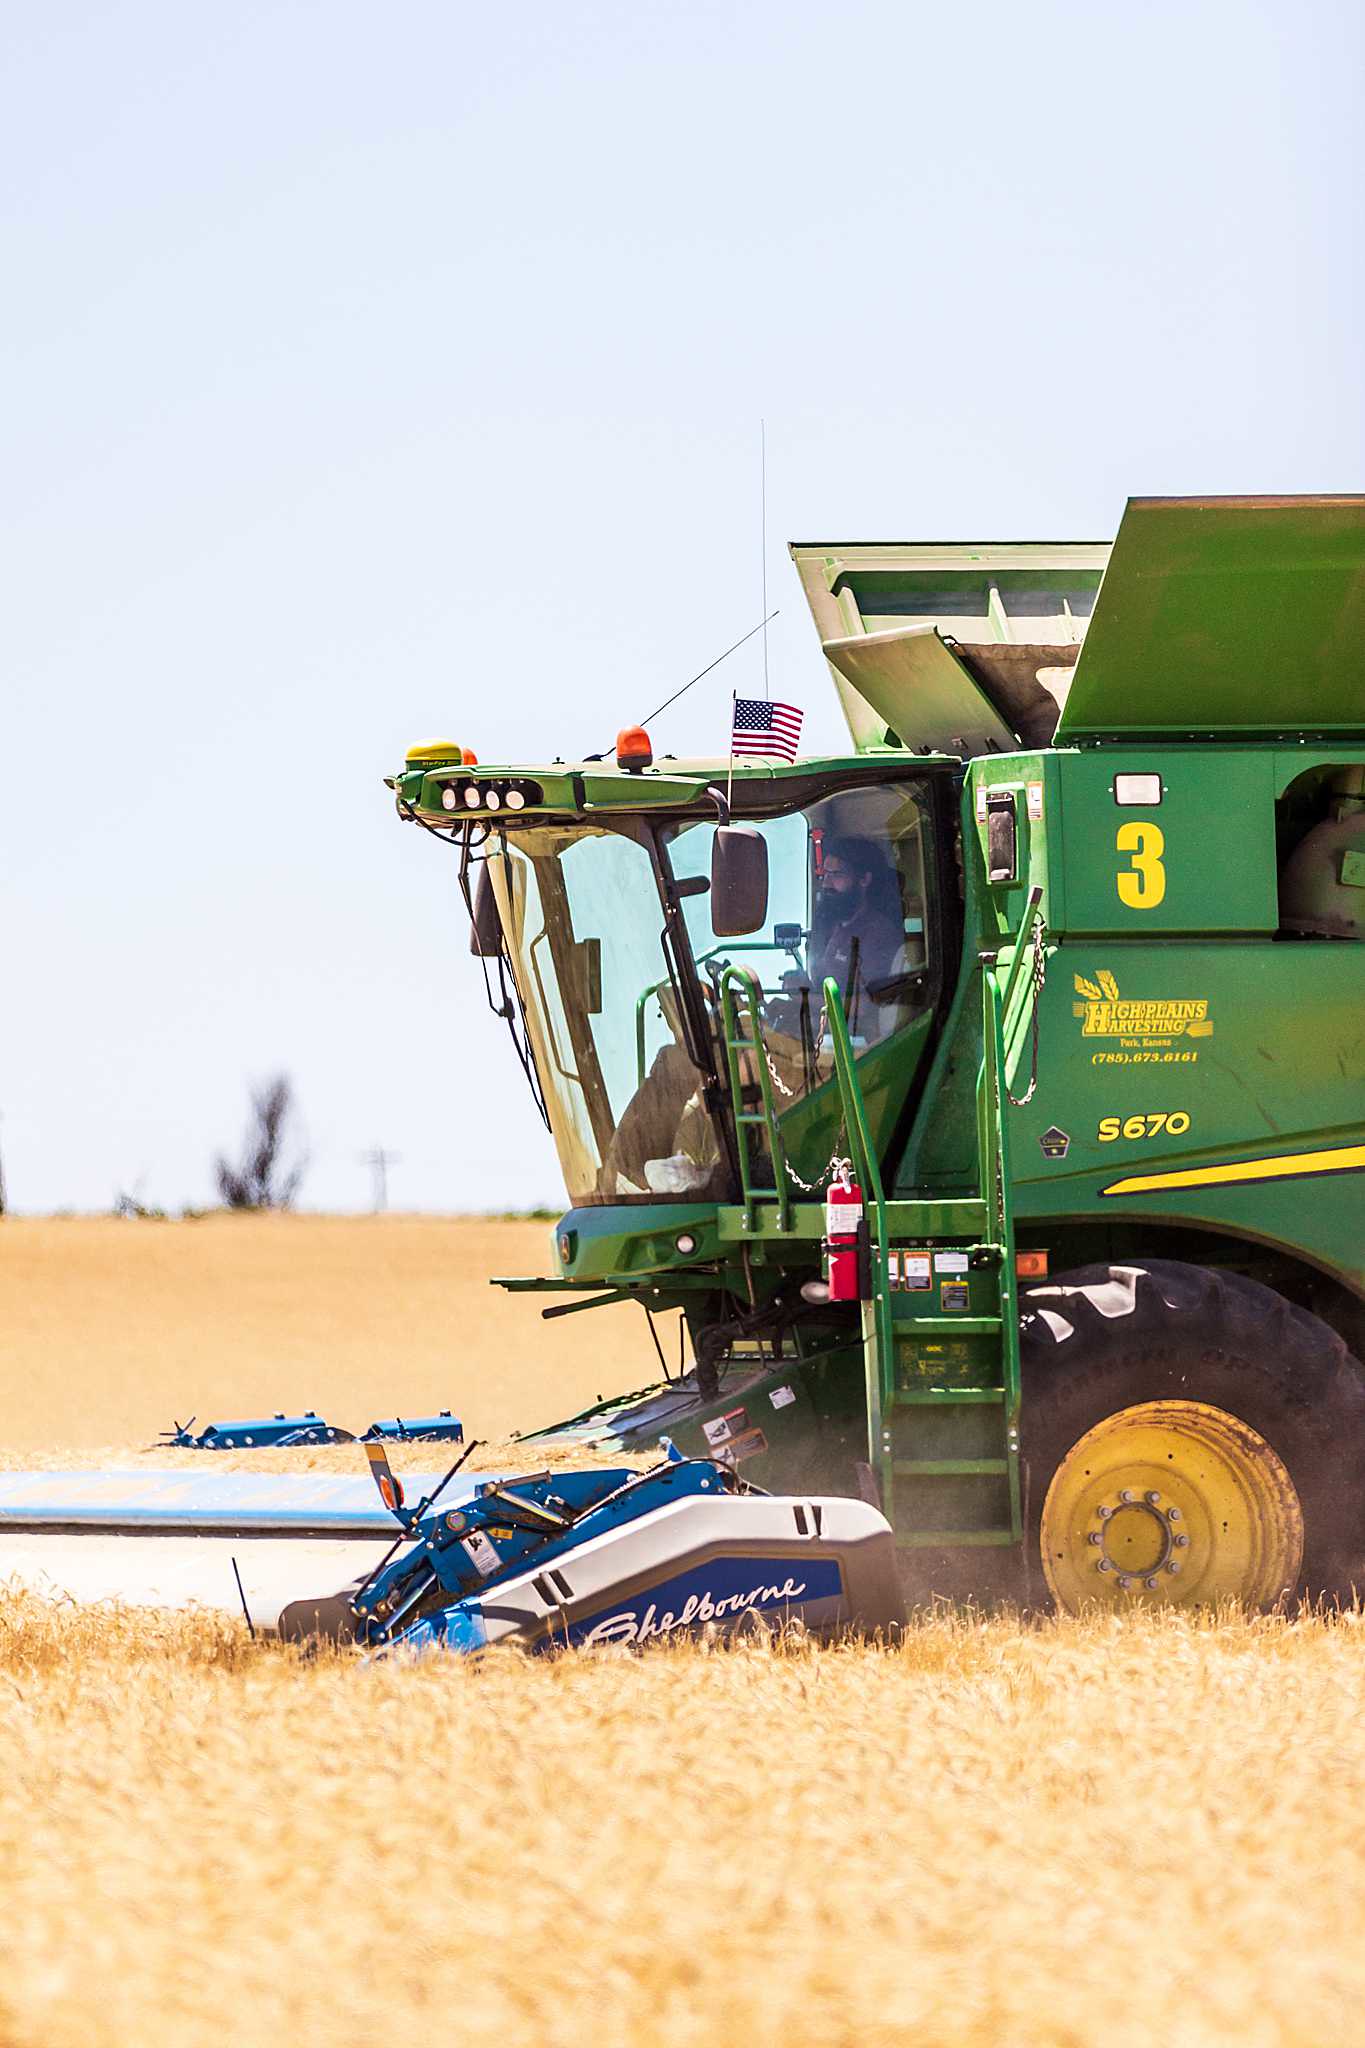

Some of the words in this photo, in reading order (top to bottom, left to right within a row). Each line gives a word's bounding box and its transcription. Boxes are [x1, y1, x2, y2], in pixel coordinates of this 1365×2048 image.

[1116, 821, 1166, 909] 3
[1145, 1002, 1206, 1019] PLAINS
[1098, 1111, 1190, 1143] S670
[584, 1578, 806, 1648] Shelbourne
